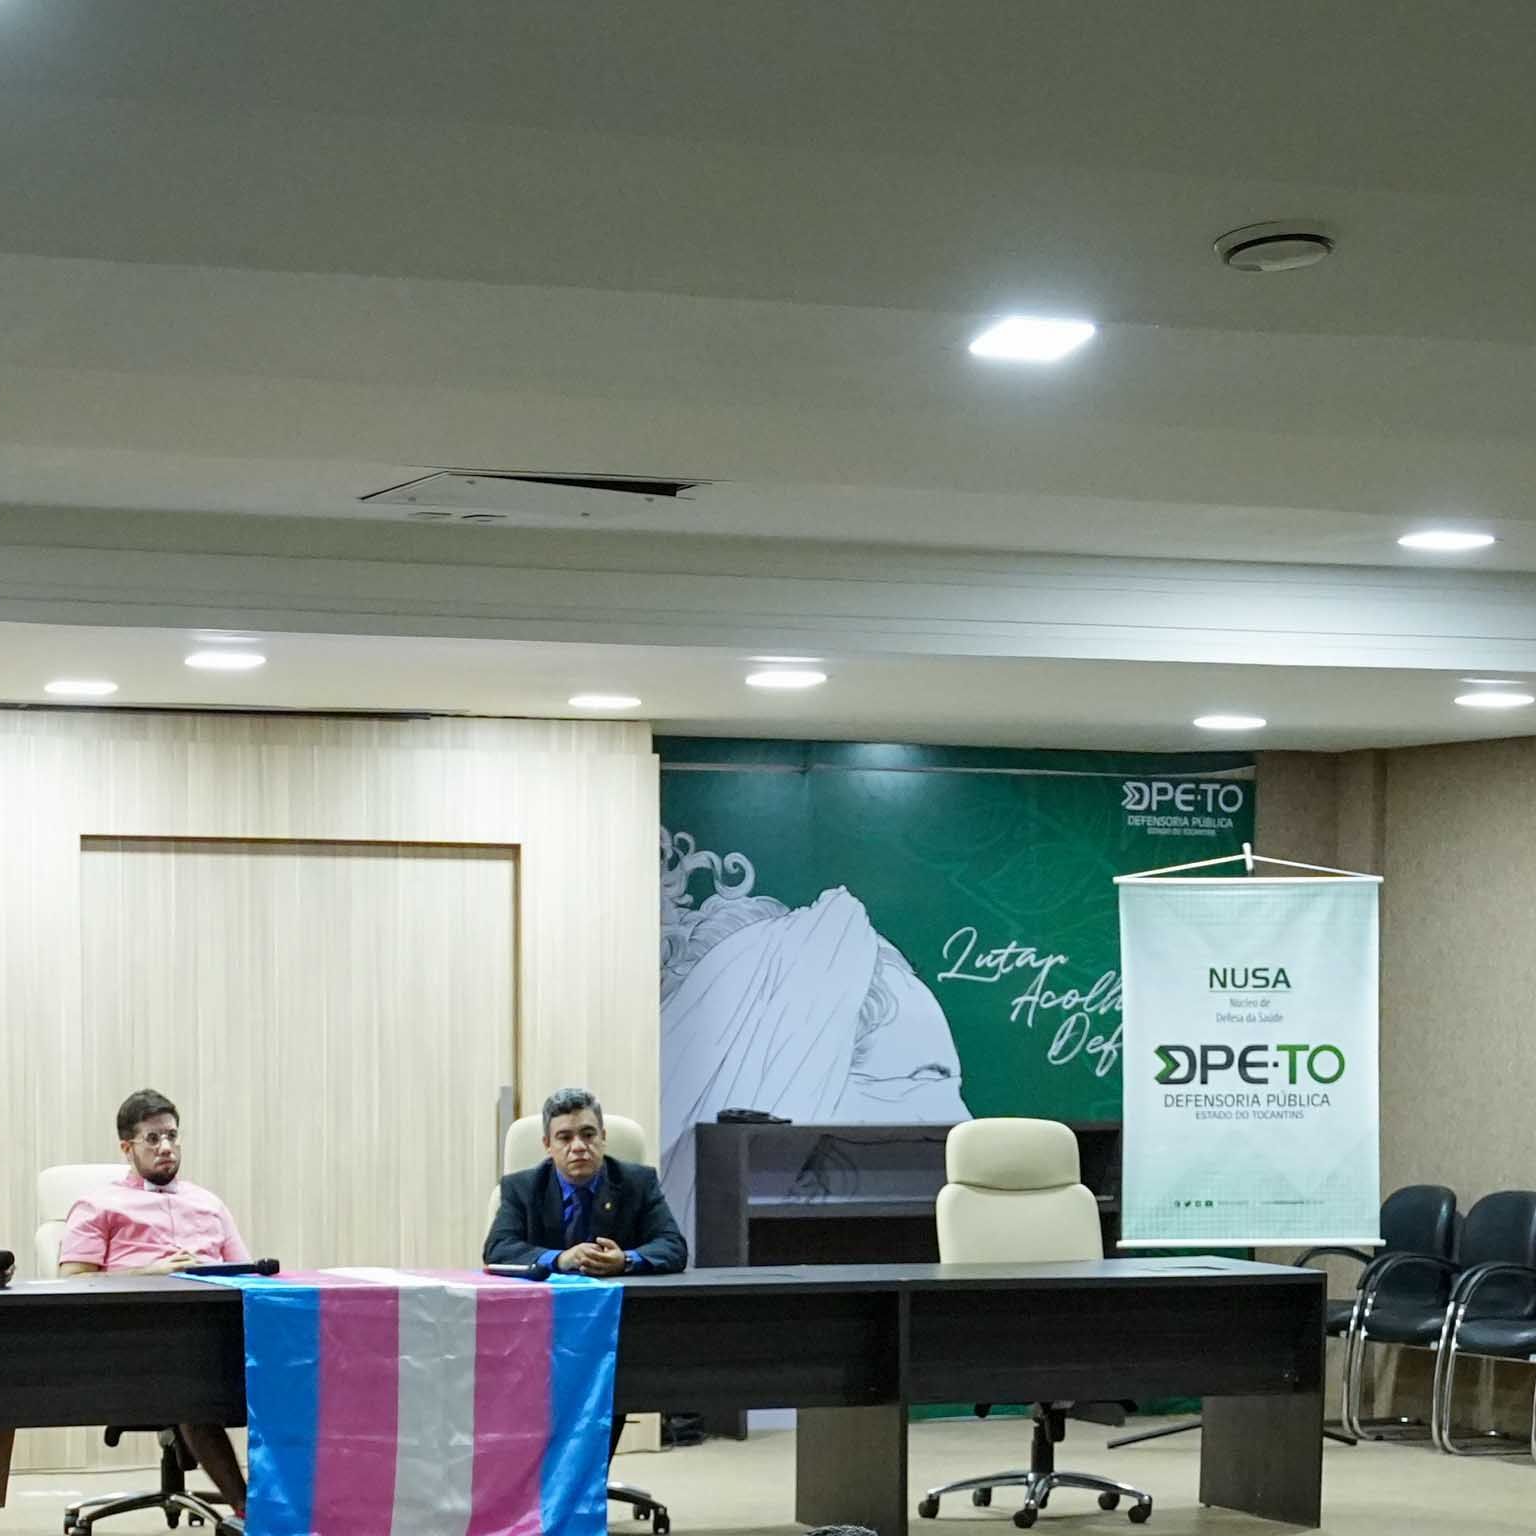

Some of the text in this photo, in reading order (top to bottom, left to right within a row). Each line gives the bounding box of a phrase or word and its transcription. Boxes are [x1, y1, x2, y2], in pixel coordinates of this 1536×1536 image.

[1127, 815, 1190, 828] DEFENSORIA
[937, 926, 1069, 982] Lutar
[1208, 967, 1292, 989] NUSA
[1259, 998, 1271, 1008] de
[1216, 1012, 1284, 1023] Defesa da Saúde
[1163, 1090, 1331, 1108] DEFENSORIA PÚBLICA
[1195, 1109, 1305, 1120] ESTADO DO TOCANTINS
